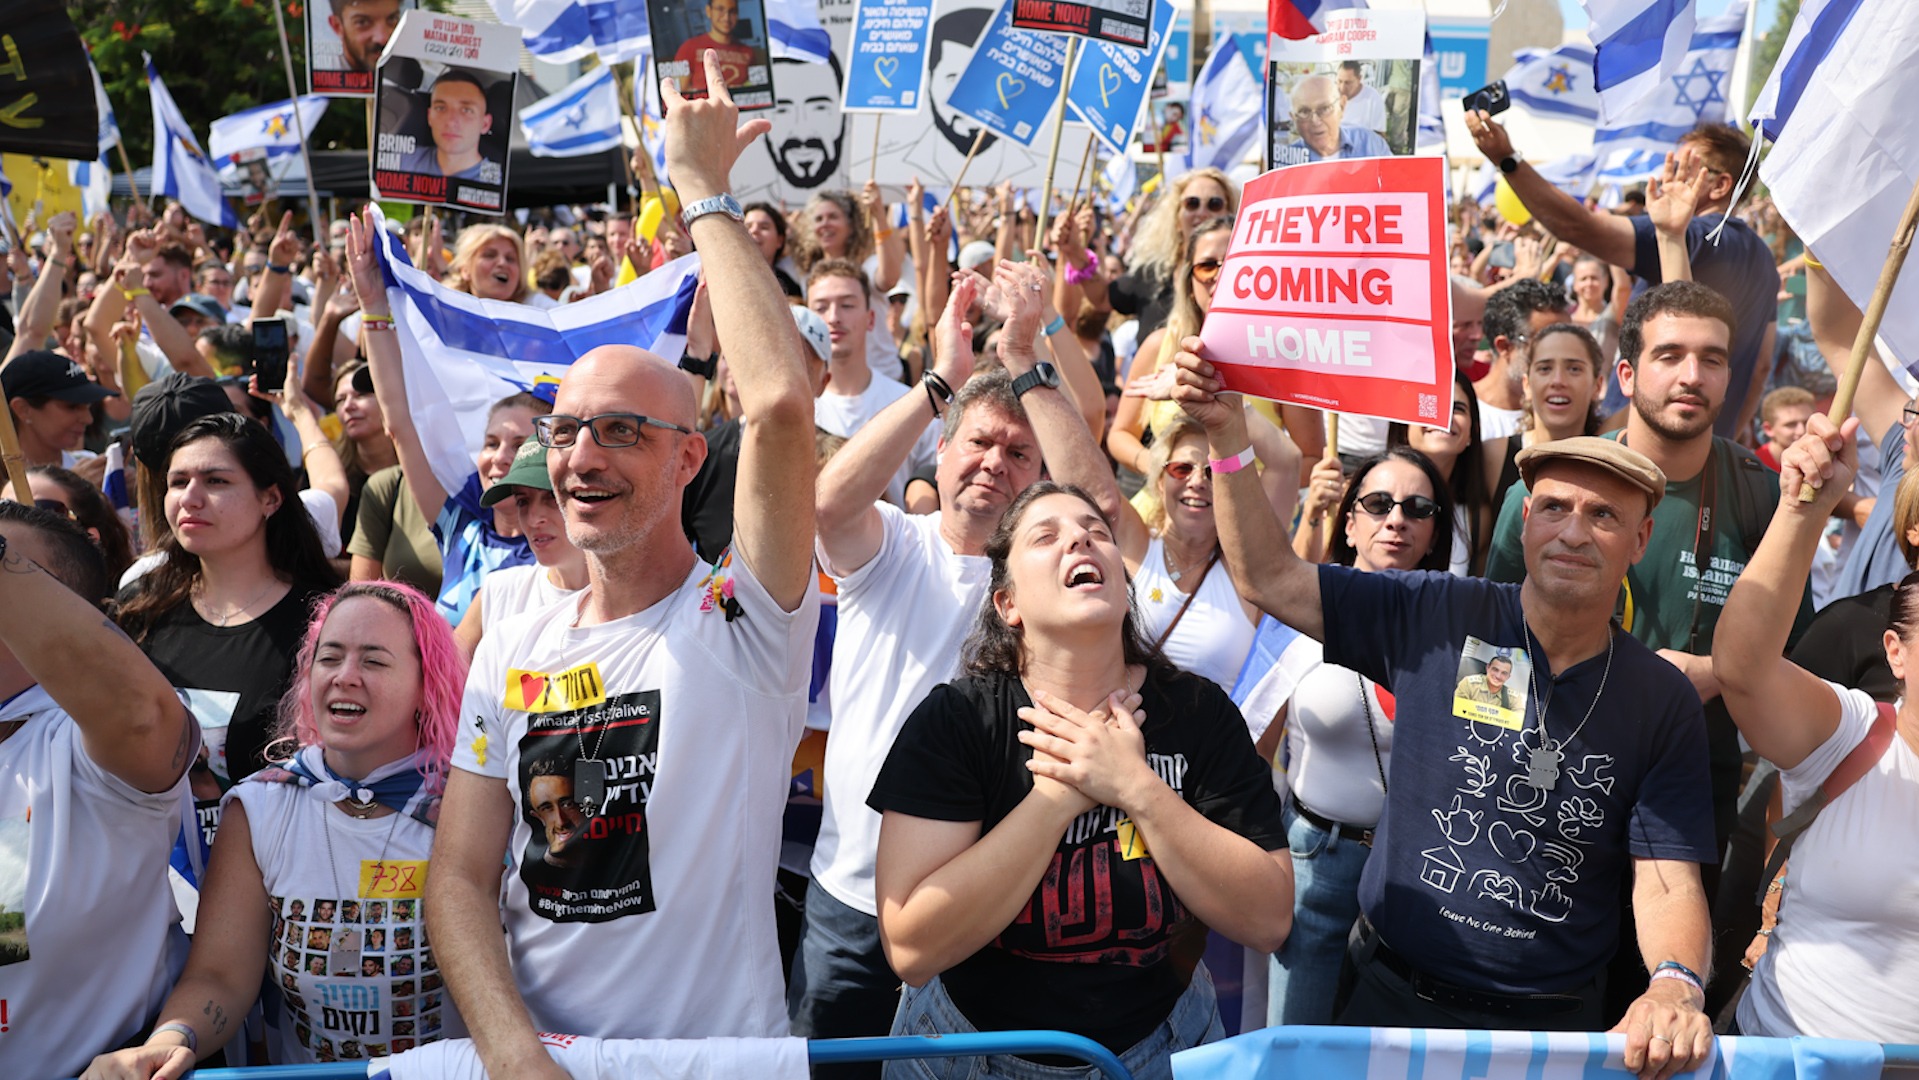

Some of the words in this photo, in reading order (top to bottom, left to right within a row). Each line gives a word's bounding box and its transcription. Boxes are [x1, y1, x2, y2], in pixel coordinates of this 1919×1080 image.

[1017, 0, 1053, 20] HOME
[1055, 3, 1091, 26] NOW!
[424, 29, 448, 43] MATAN
[450, 34, 482, 48] ANGREST
[1347, 30, 1377, 41] COOPER
[313, 71, 343, 87] HOME
[344, 71, 374, 88] NOW!
[657, 60, 691, 78] BRING
[378, 133, 416, 154] BRING
[1273, 143, 1311, 165] BRING
[377, 152, 401, 171] HIM
[376, 171, 411, 191] HOME
[412, 176, 448, 196] NOW!
[1244, 204, 1403, 246] THEY'RE
[1233, 265, 1393, 306] COMING
[1247, 324, 1373, 367] HOME
[1701, 507, 1711, 531] EOS
[615, 703, 651, 719] alive.
[582, 813, 642, 840] חיים.
[369, 865, 417, 893] 738
[1482, 921, 1502, 934] One
[1503, 927, 1537, 940] Behind
